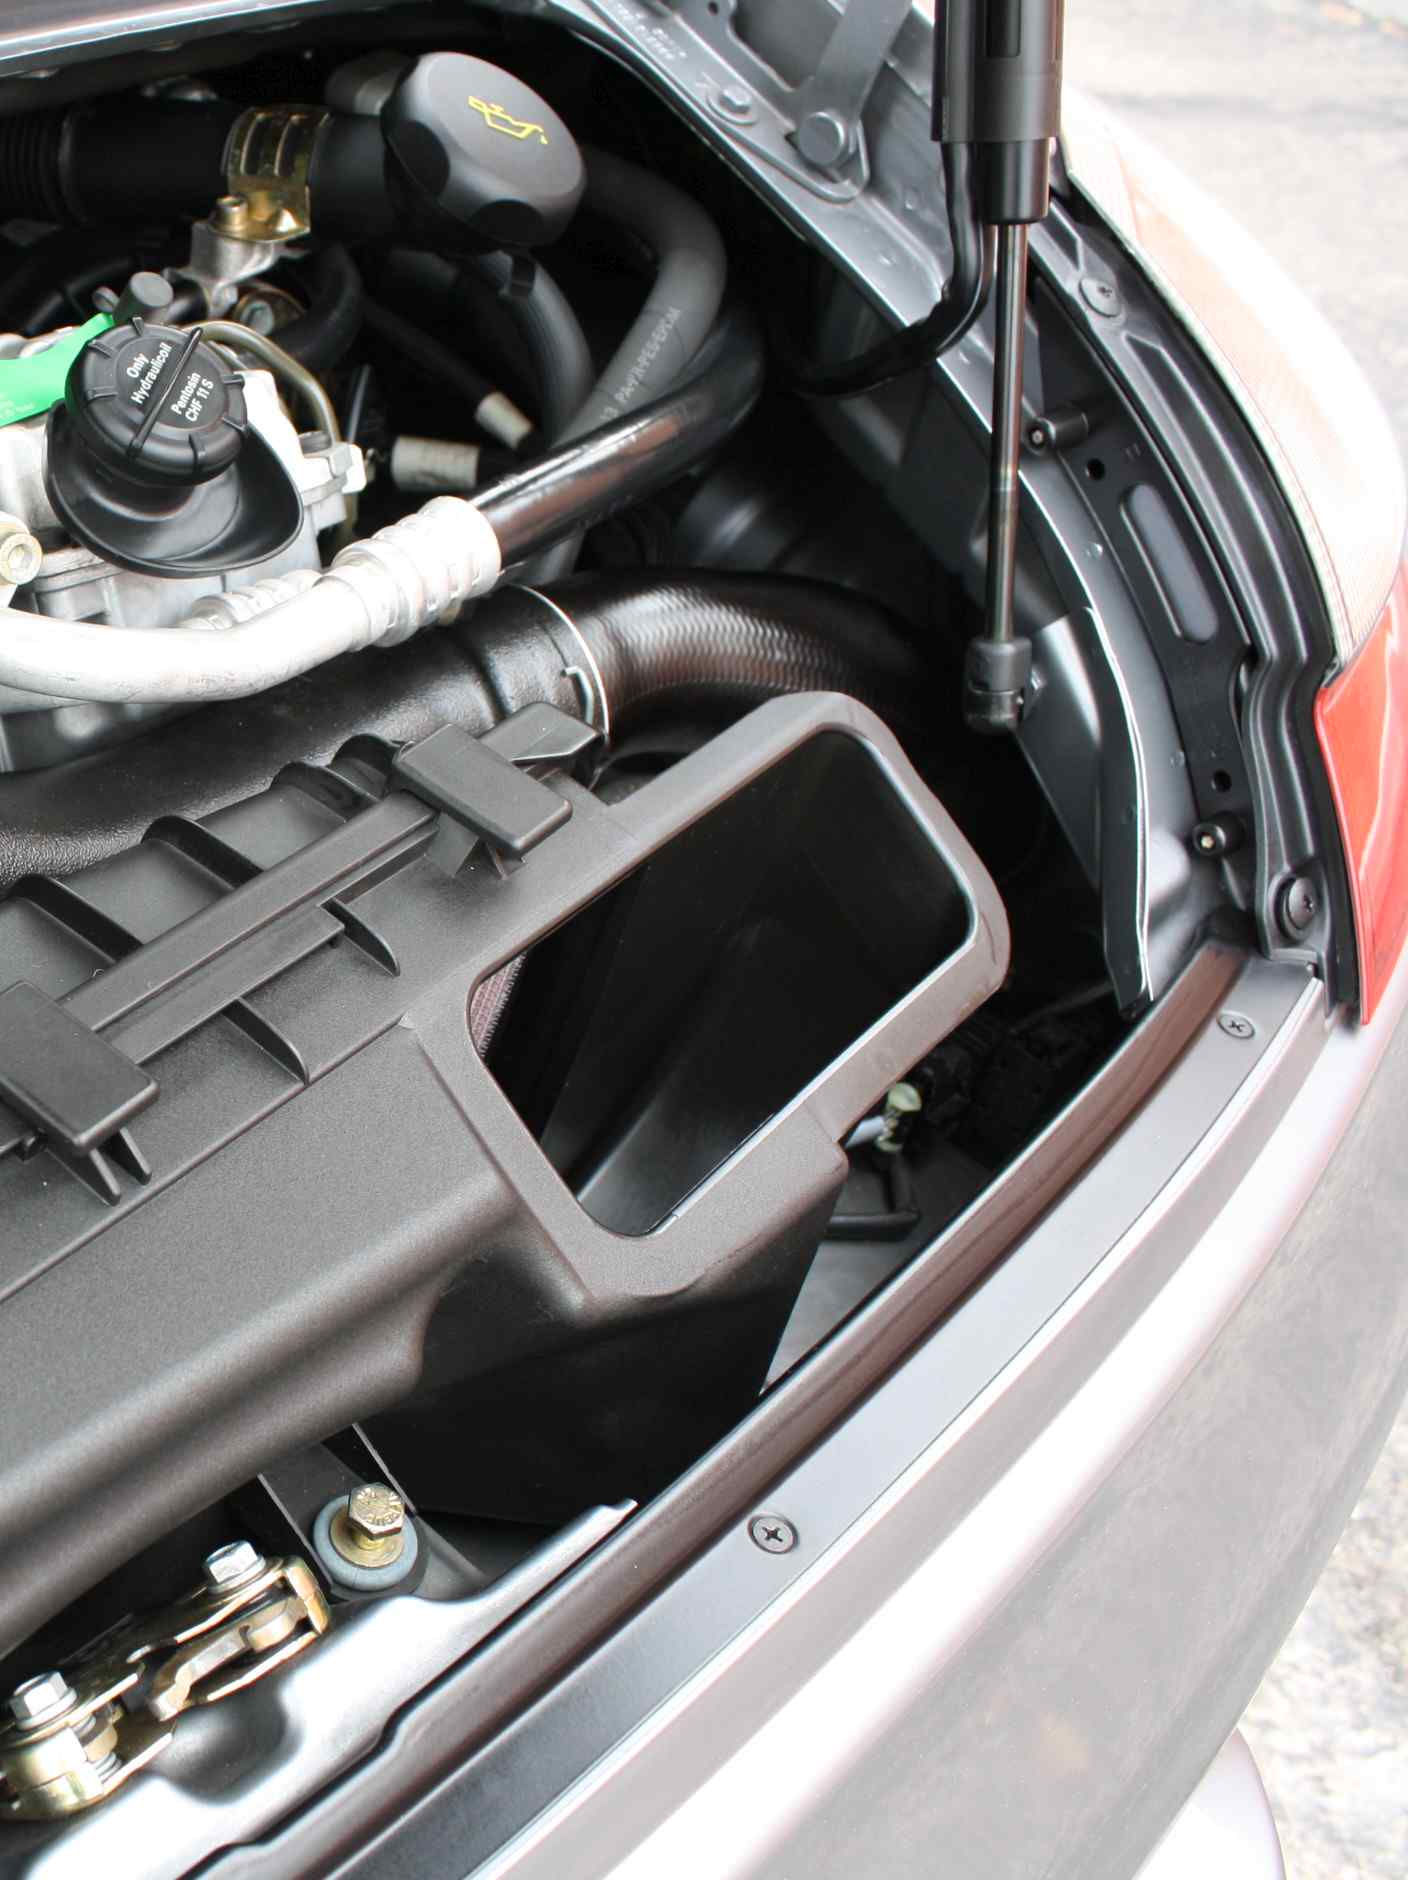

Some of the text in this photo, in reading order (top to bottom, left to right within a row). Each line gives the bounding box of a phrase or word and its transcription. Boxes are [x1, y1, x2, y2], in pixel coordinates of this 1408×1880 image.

[126, 352, 149, 378] Only
[130, 341, 172, 405] Hydraulicoil
[170, 372, 201, 415] Pentosin
[185, 378, 214, 421] CHF 11 S
